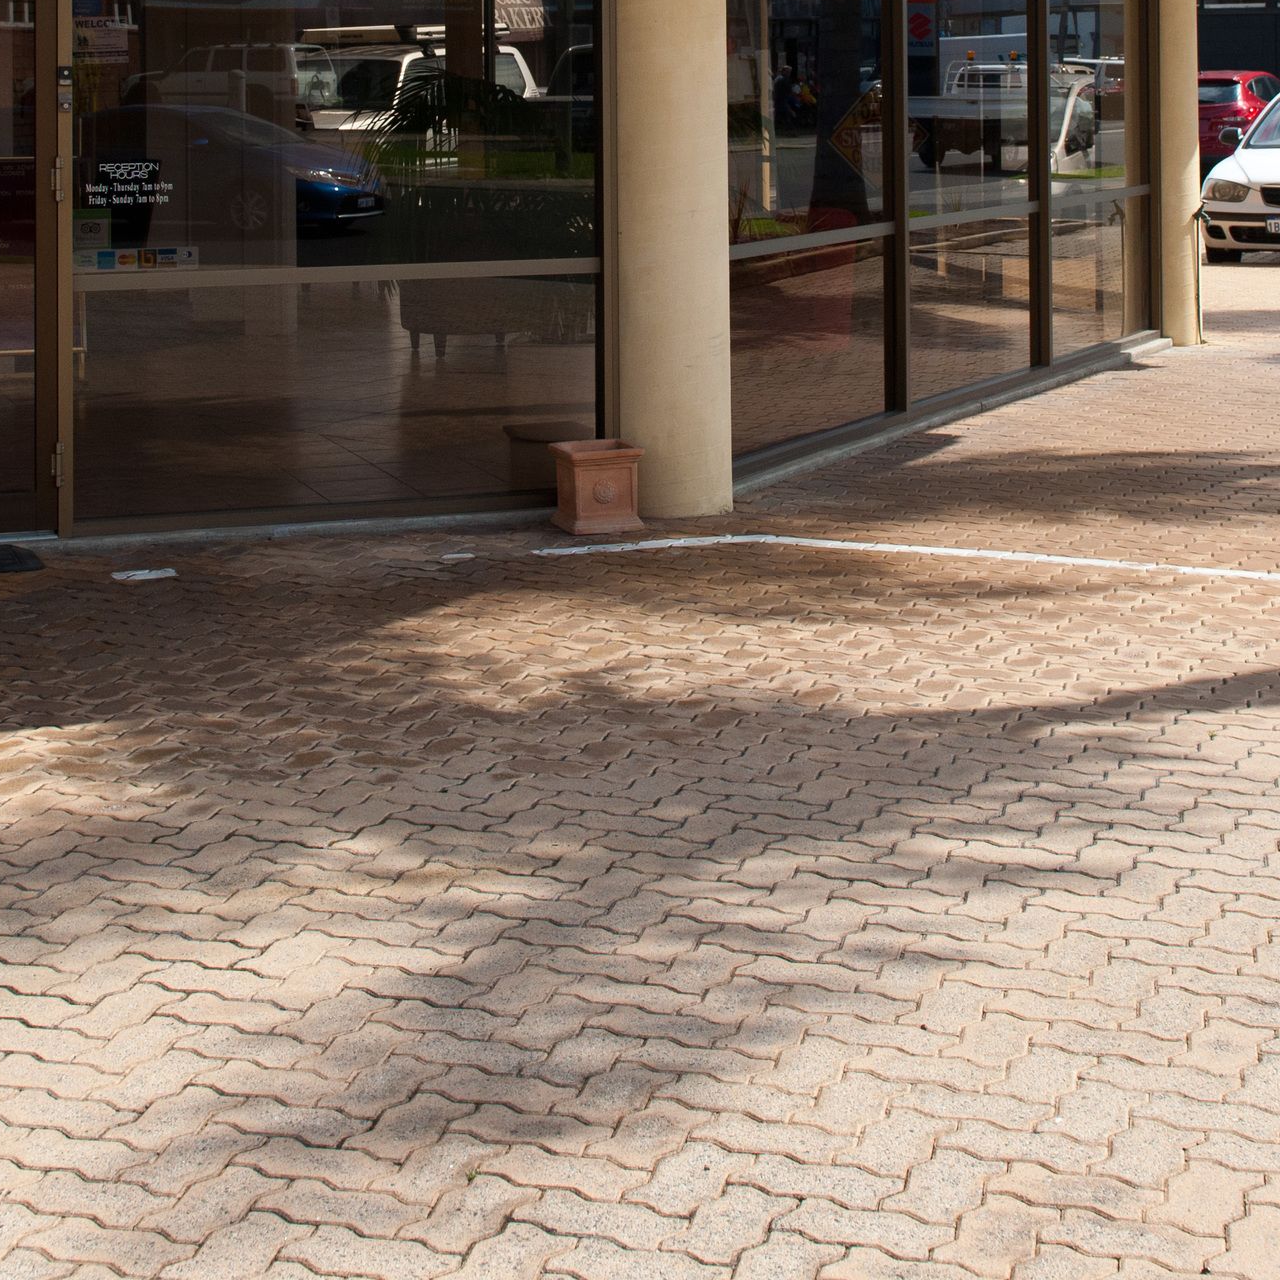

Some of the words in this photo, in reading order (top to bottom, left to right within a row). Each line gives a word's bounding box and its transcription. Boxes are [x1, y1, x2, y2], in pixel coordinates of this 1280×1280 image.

[99, 162, 160, 172] RECEPTION
[109, 171, 149, 179] HOURS
[85, 183, 108, 194] Monday
[113, 182, 140, 193] Thursday
[88, 195, 107, 206] Friday
[112, 194, 134, 205] Sunday
